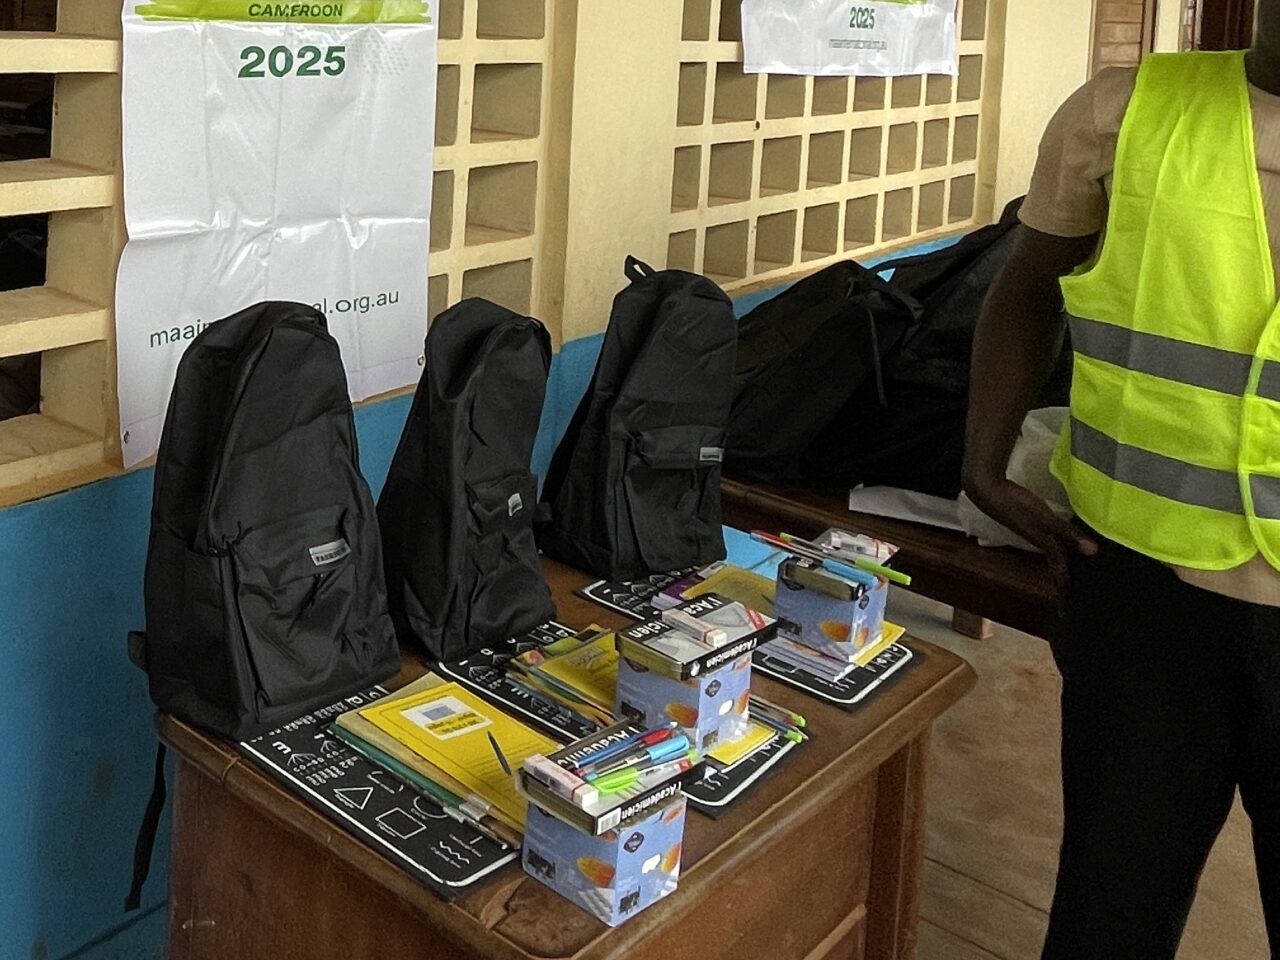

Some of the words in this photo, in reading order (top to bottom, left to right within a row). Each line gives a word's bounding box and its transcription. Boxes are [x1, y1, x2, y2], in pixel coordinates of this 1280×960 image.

[247, 3, 343, 18] CAMEROON
[849, 5, 875, 30] 2025
[238, 44, 347, 79] 2025
